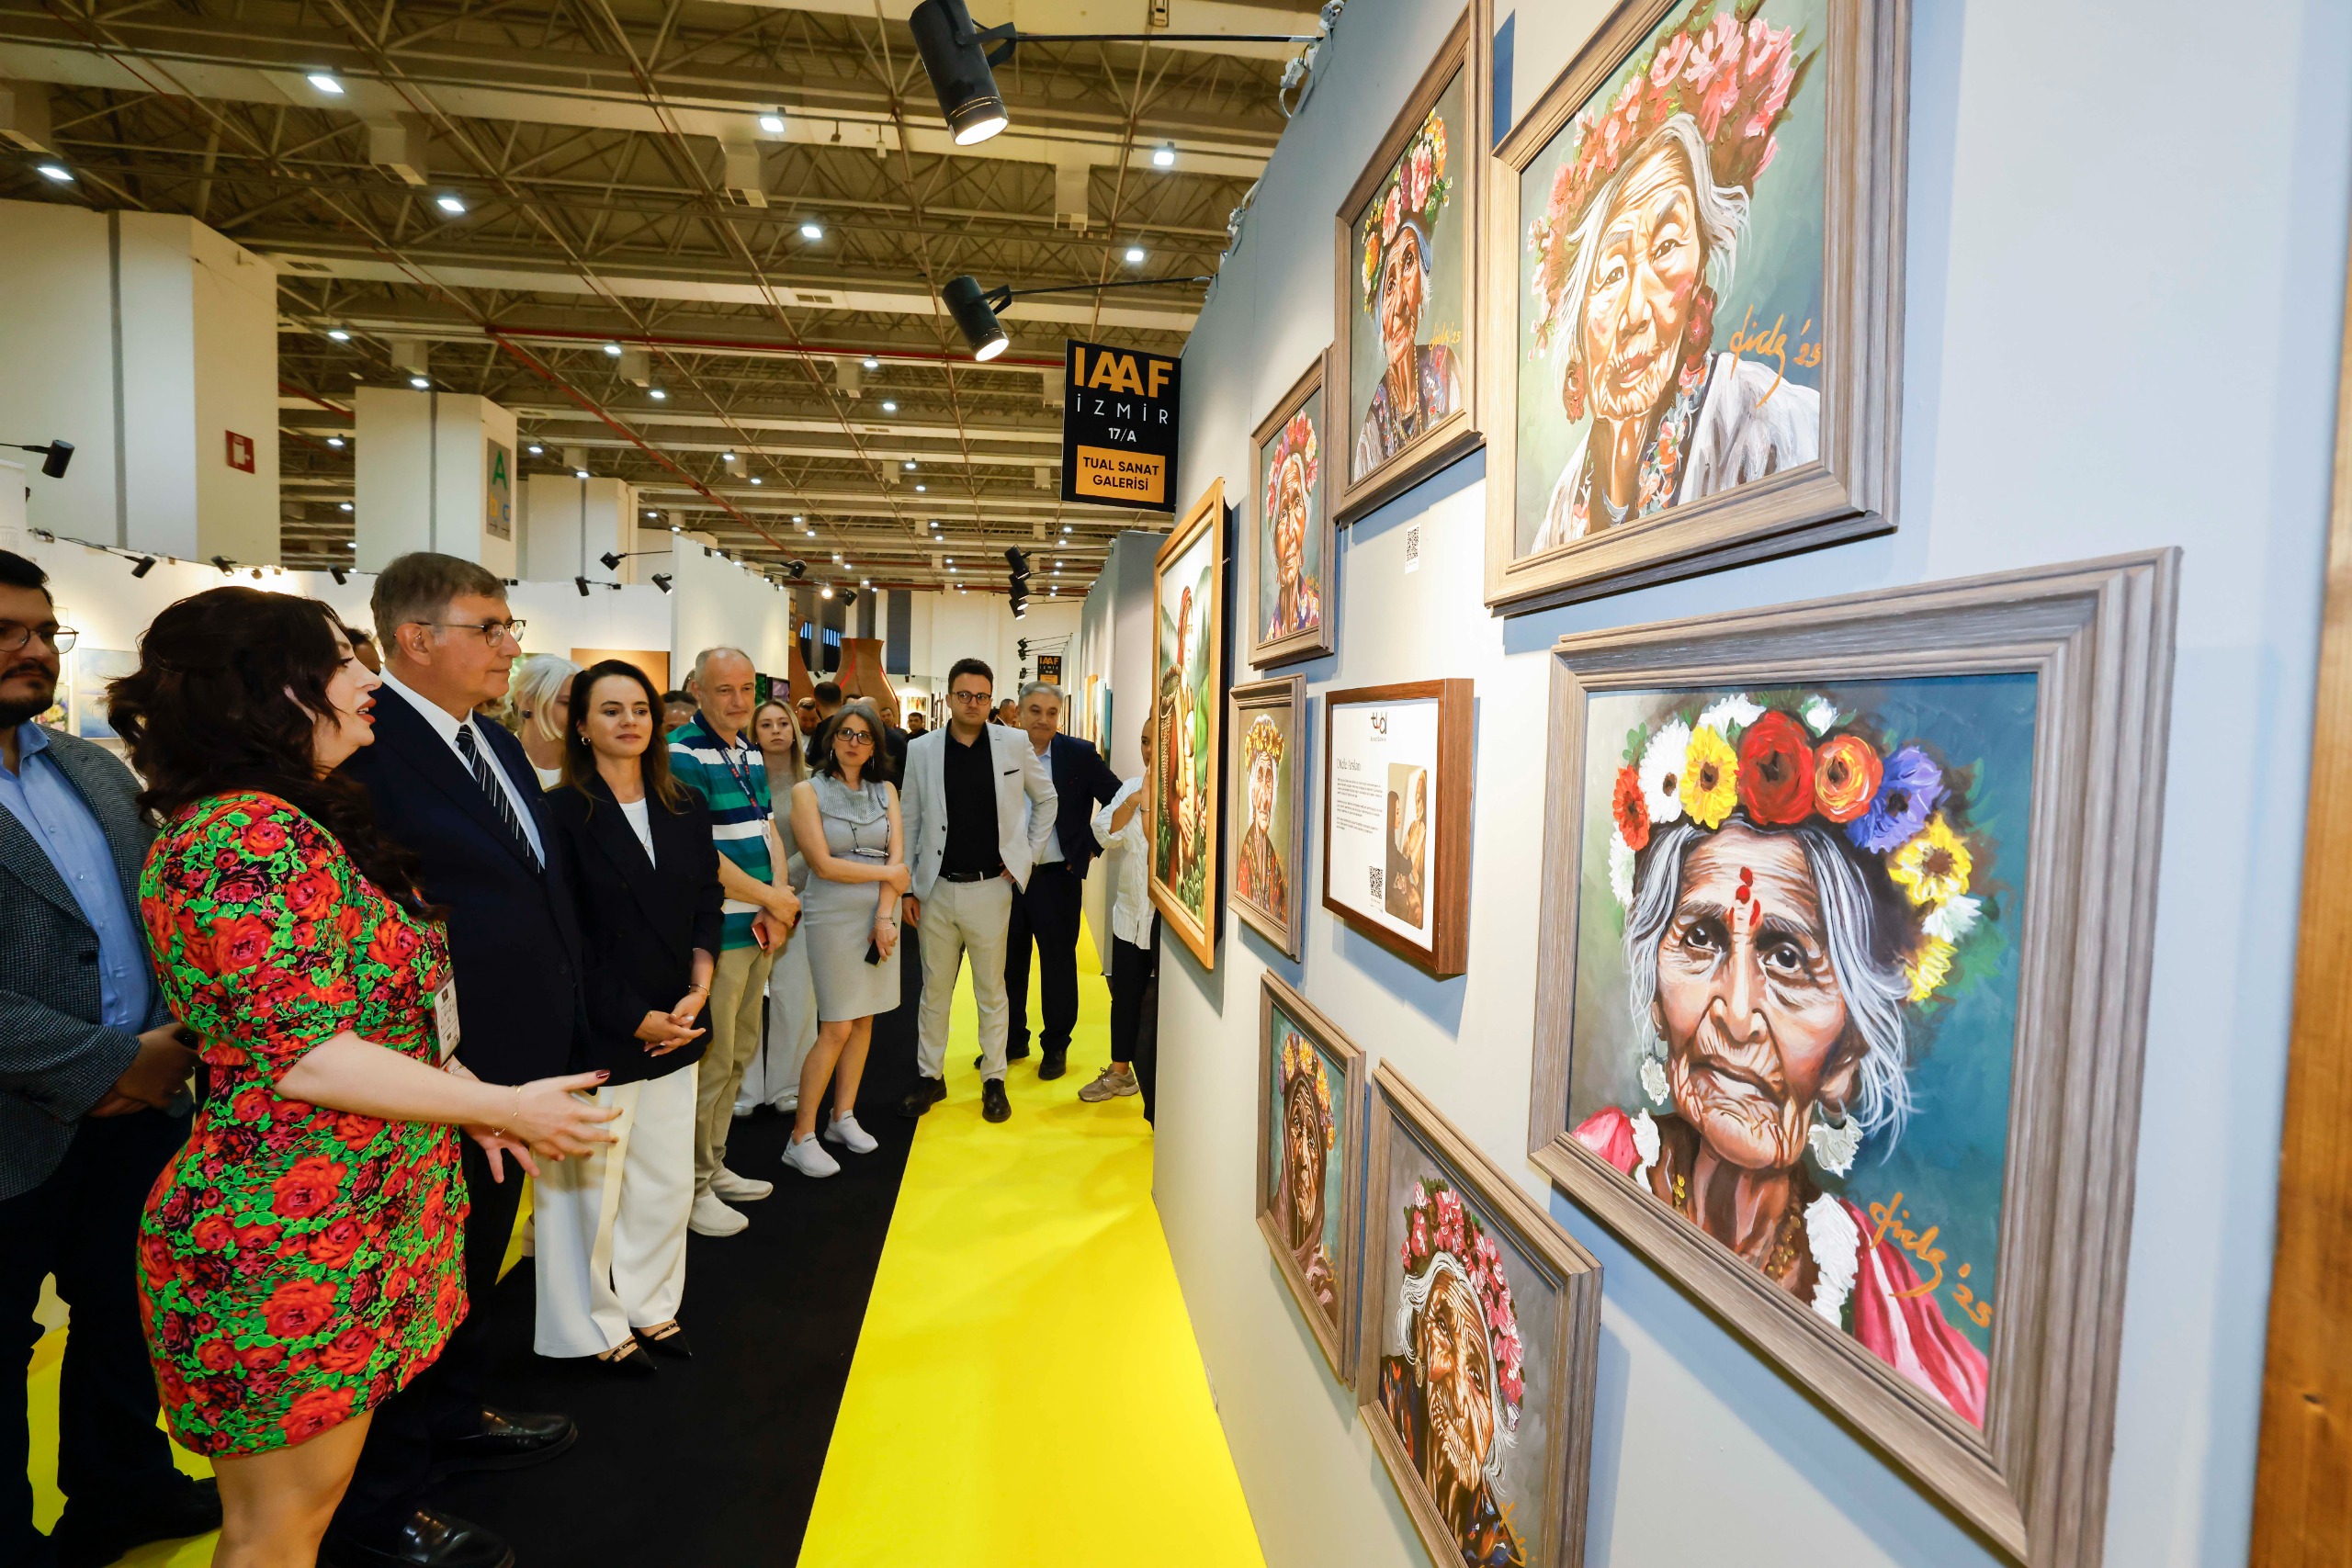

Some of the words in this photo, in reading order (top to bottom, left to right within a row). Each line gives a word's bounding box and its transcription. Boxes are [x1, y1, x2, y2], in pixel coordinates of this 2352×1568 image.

[1074, 346, 1173, 399] IAAF
[1077, 393, 1169, 424] İZMİR
[1108, 427, 1137, 443] 17/A
[492, 448, 508, 491] A
[1082, 457, 1114, 471] TUAL
[1118, 460, 1159, 476] SANAT
[1092, 474, 1148, 491] GALERİSİ
[1039, 657, 1059, 665] IAAF
